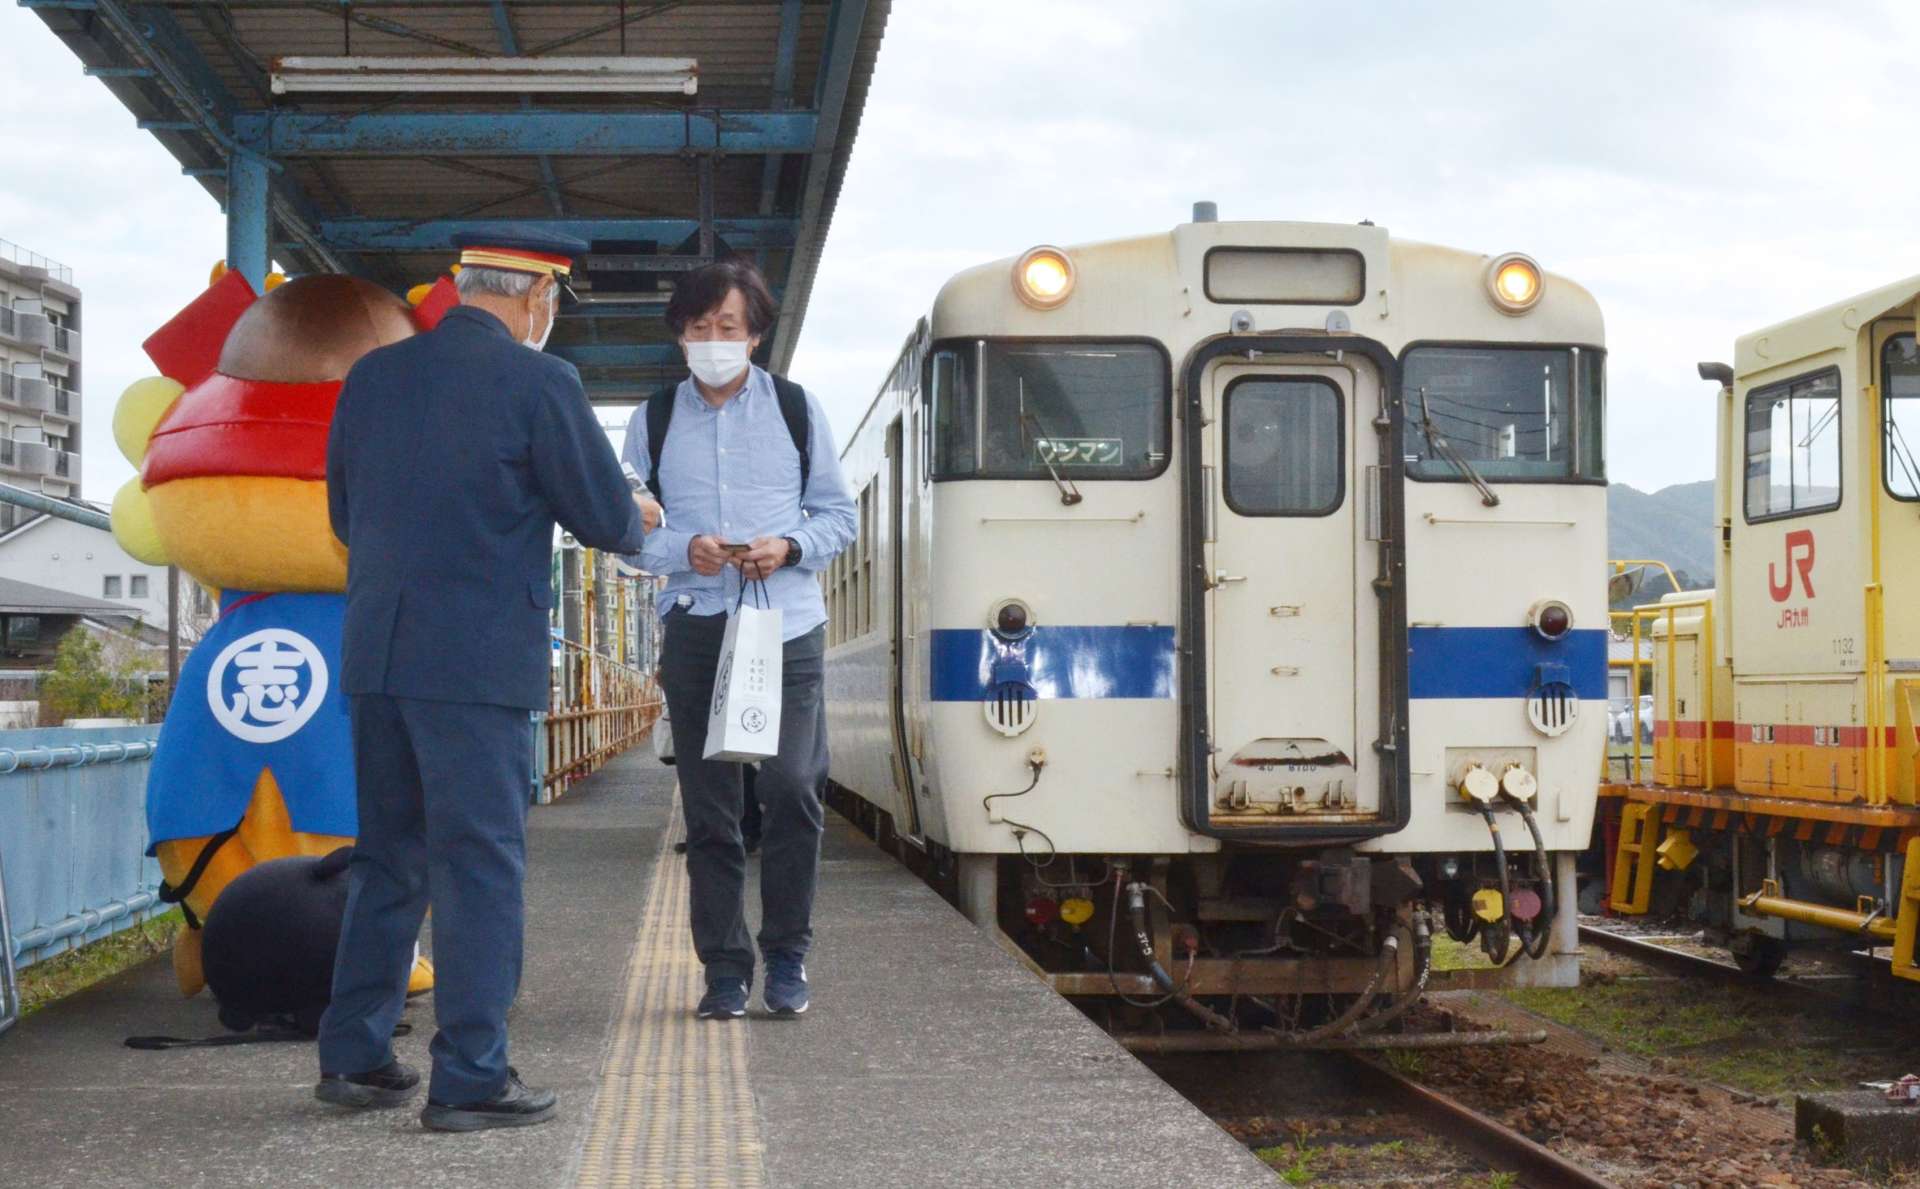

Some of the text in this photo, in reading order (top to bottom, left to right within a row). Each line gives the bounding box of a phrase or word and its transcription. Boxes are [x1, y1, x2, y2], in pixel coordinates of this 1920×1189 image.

[1038, 441, 1120, 462] ワンマン
[1768, 529, 1816, 602] JR
[1777, 607, 1808, 628] JR九州
[1832, 637, 1854, 654] 1132
[231, 638, 309, 725] 志
